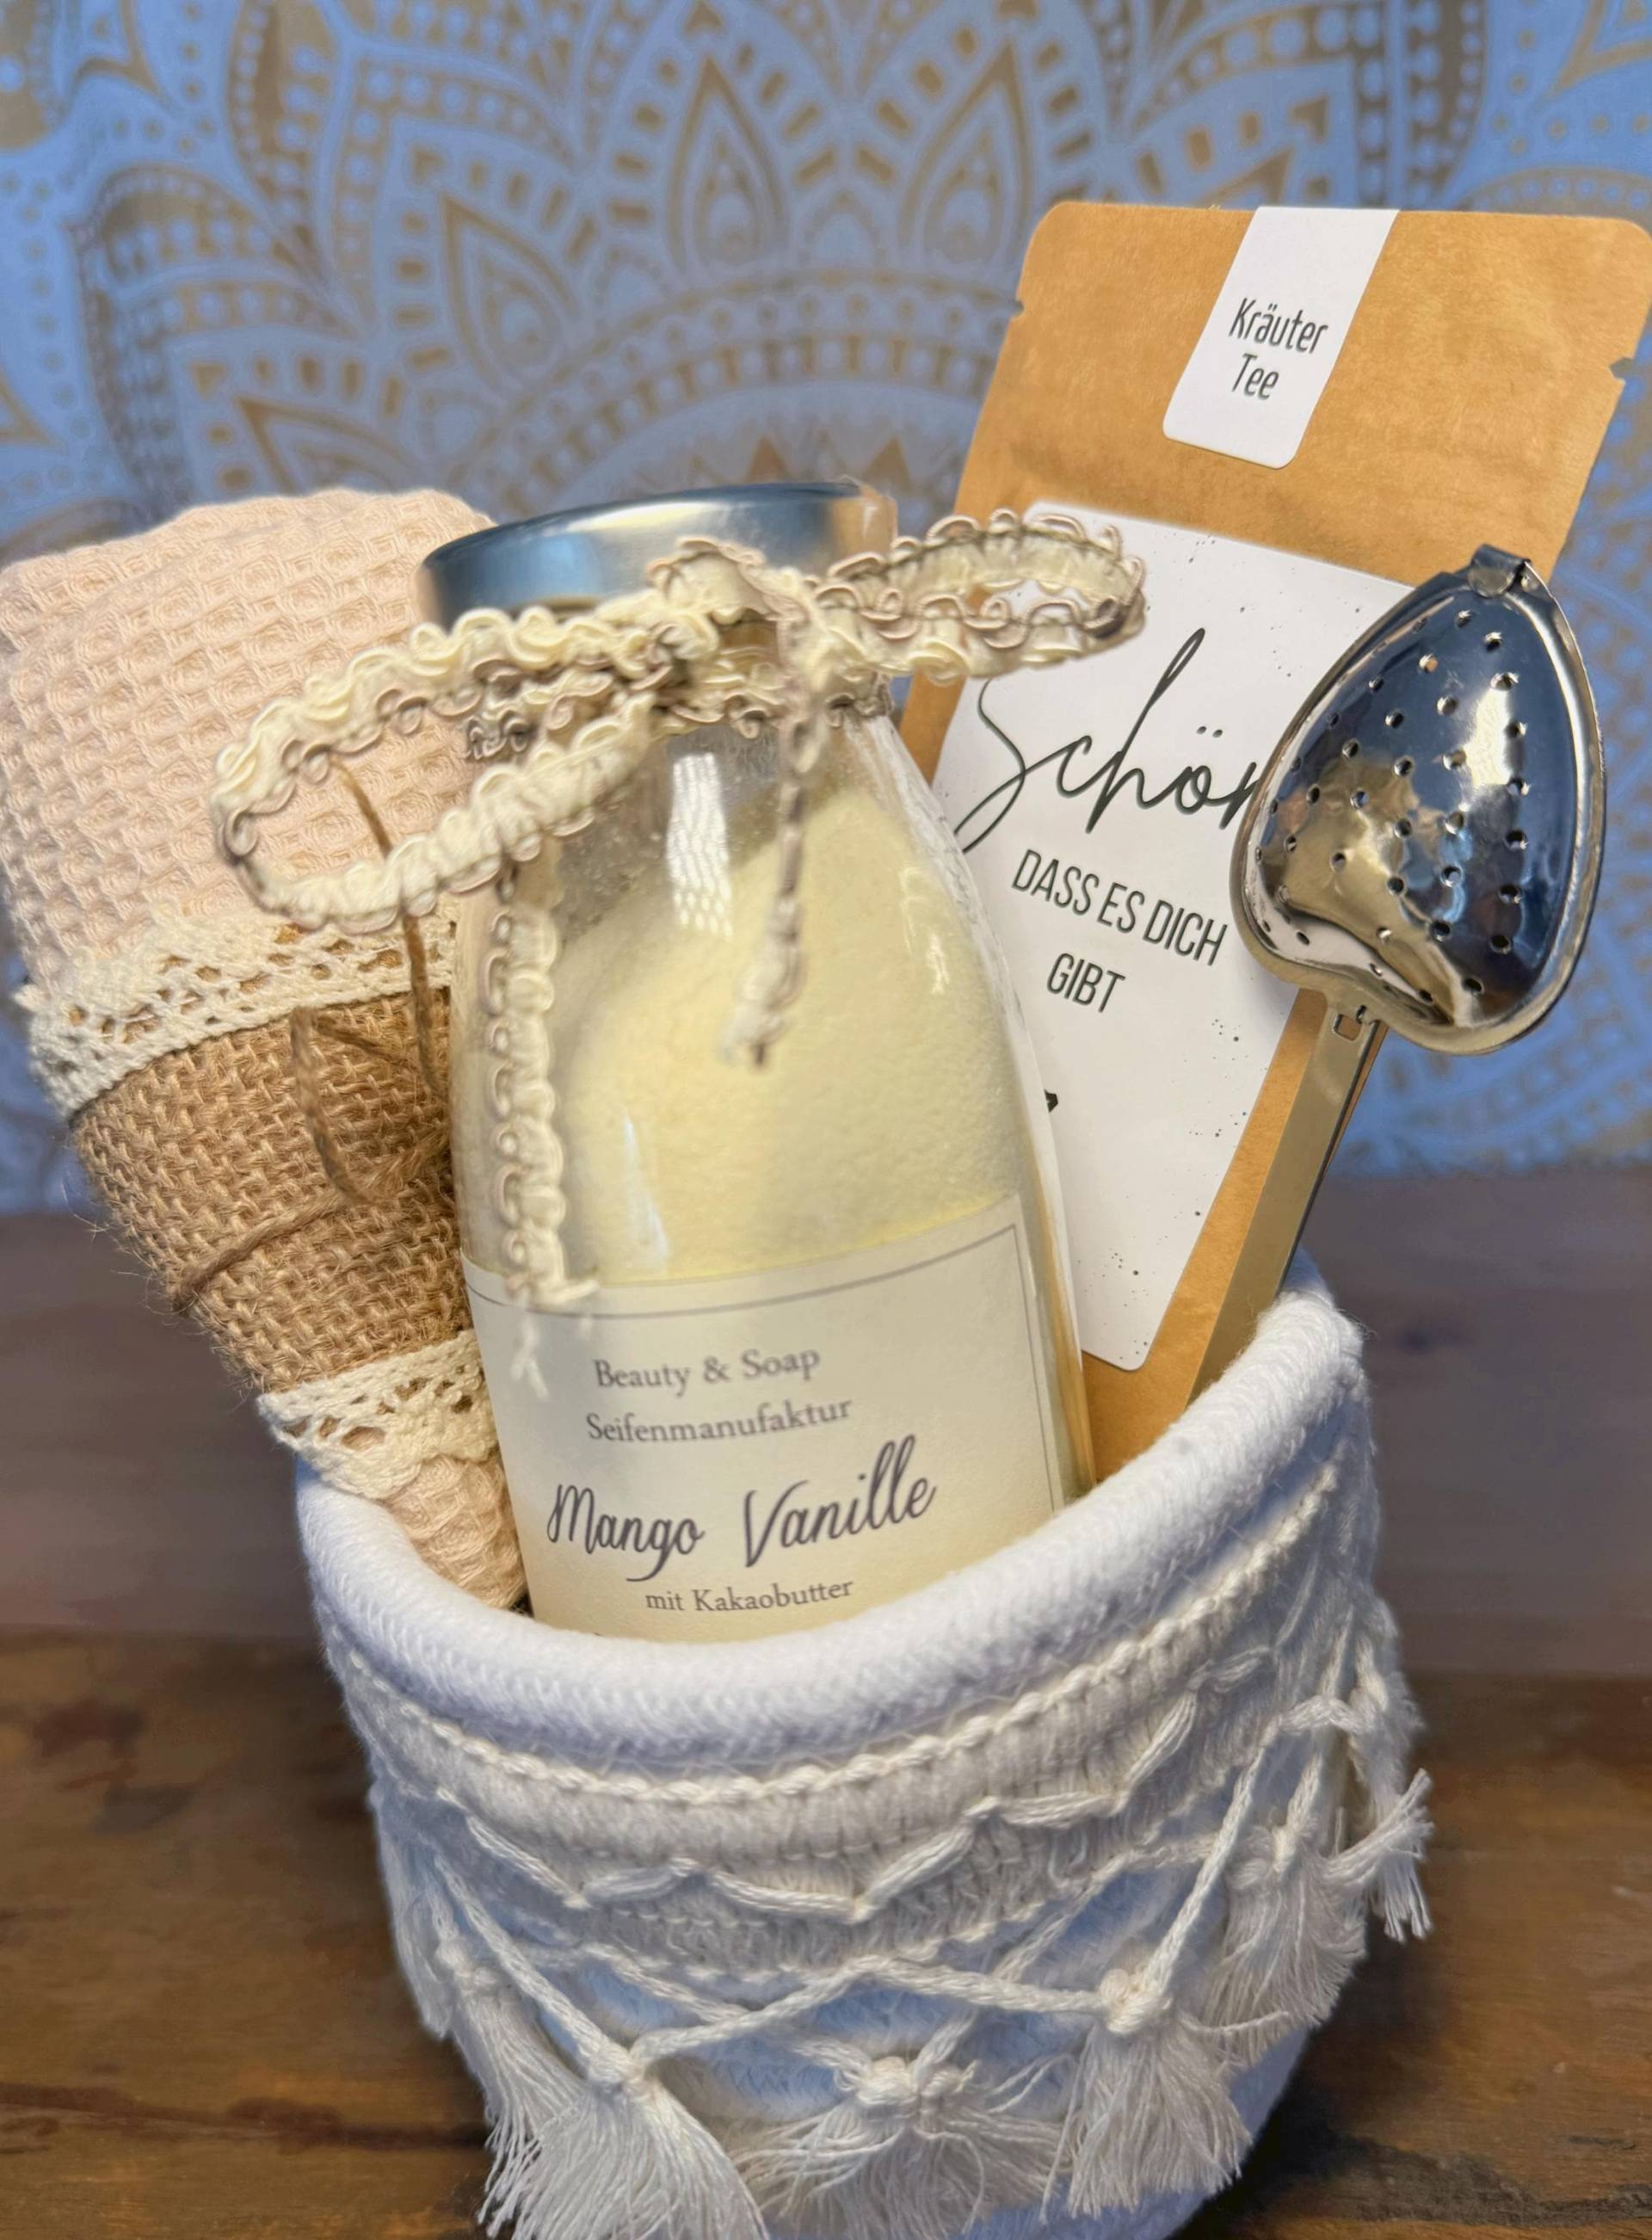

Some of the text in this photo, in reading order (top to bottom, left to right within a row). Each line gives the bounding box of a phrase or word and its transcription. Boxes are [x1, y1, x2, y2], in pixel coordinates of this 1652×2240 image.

[1228, 296, 1329, 355] Kräuter
[1231, 352, 1280, 401] Tee
[1011, 848, 1229, 967] DASS ES DICH
[1045, 952, 1127, 1014] GIBT
[592, 1348, 822, 1398] Beauty & Soap
[584, 1398, 854, 1443] Seifenmanufaktur
[546, 1432, 938, 1583] Mango Vanille
[644, 1577, 854, 1613] mit Kakaobutter
